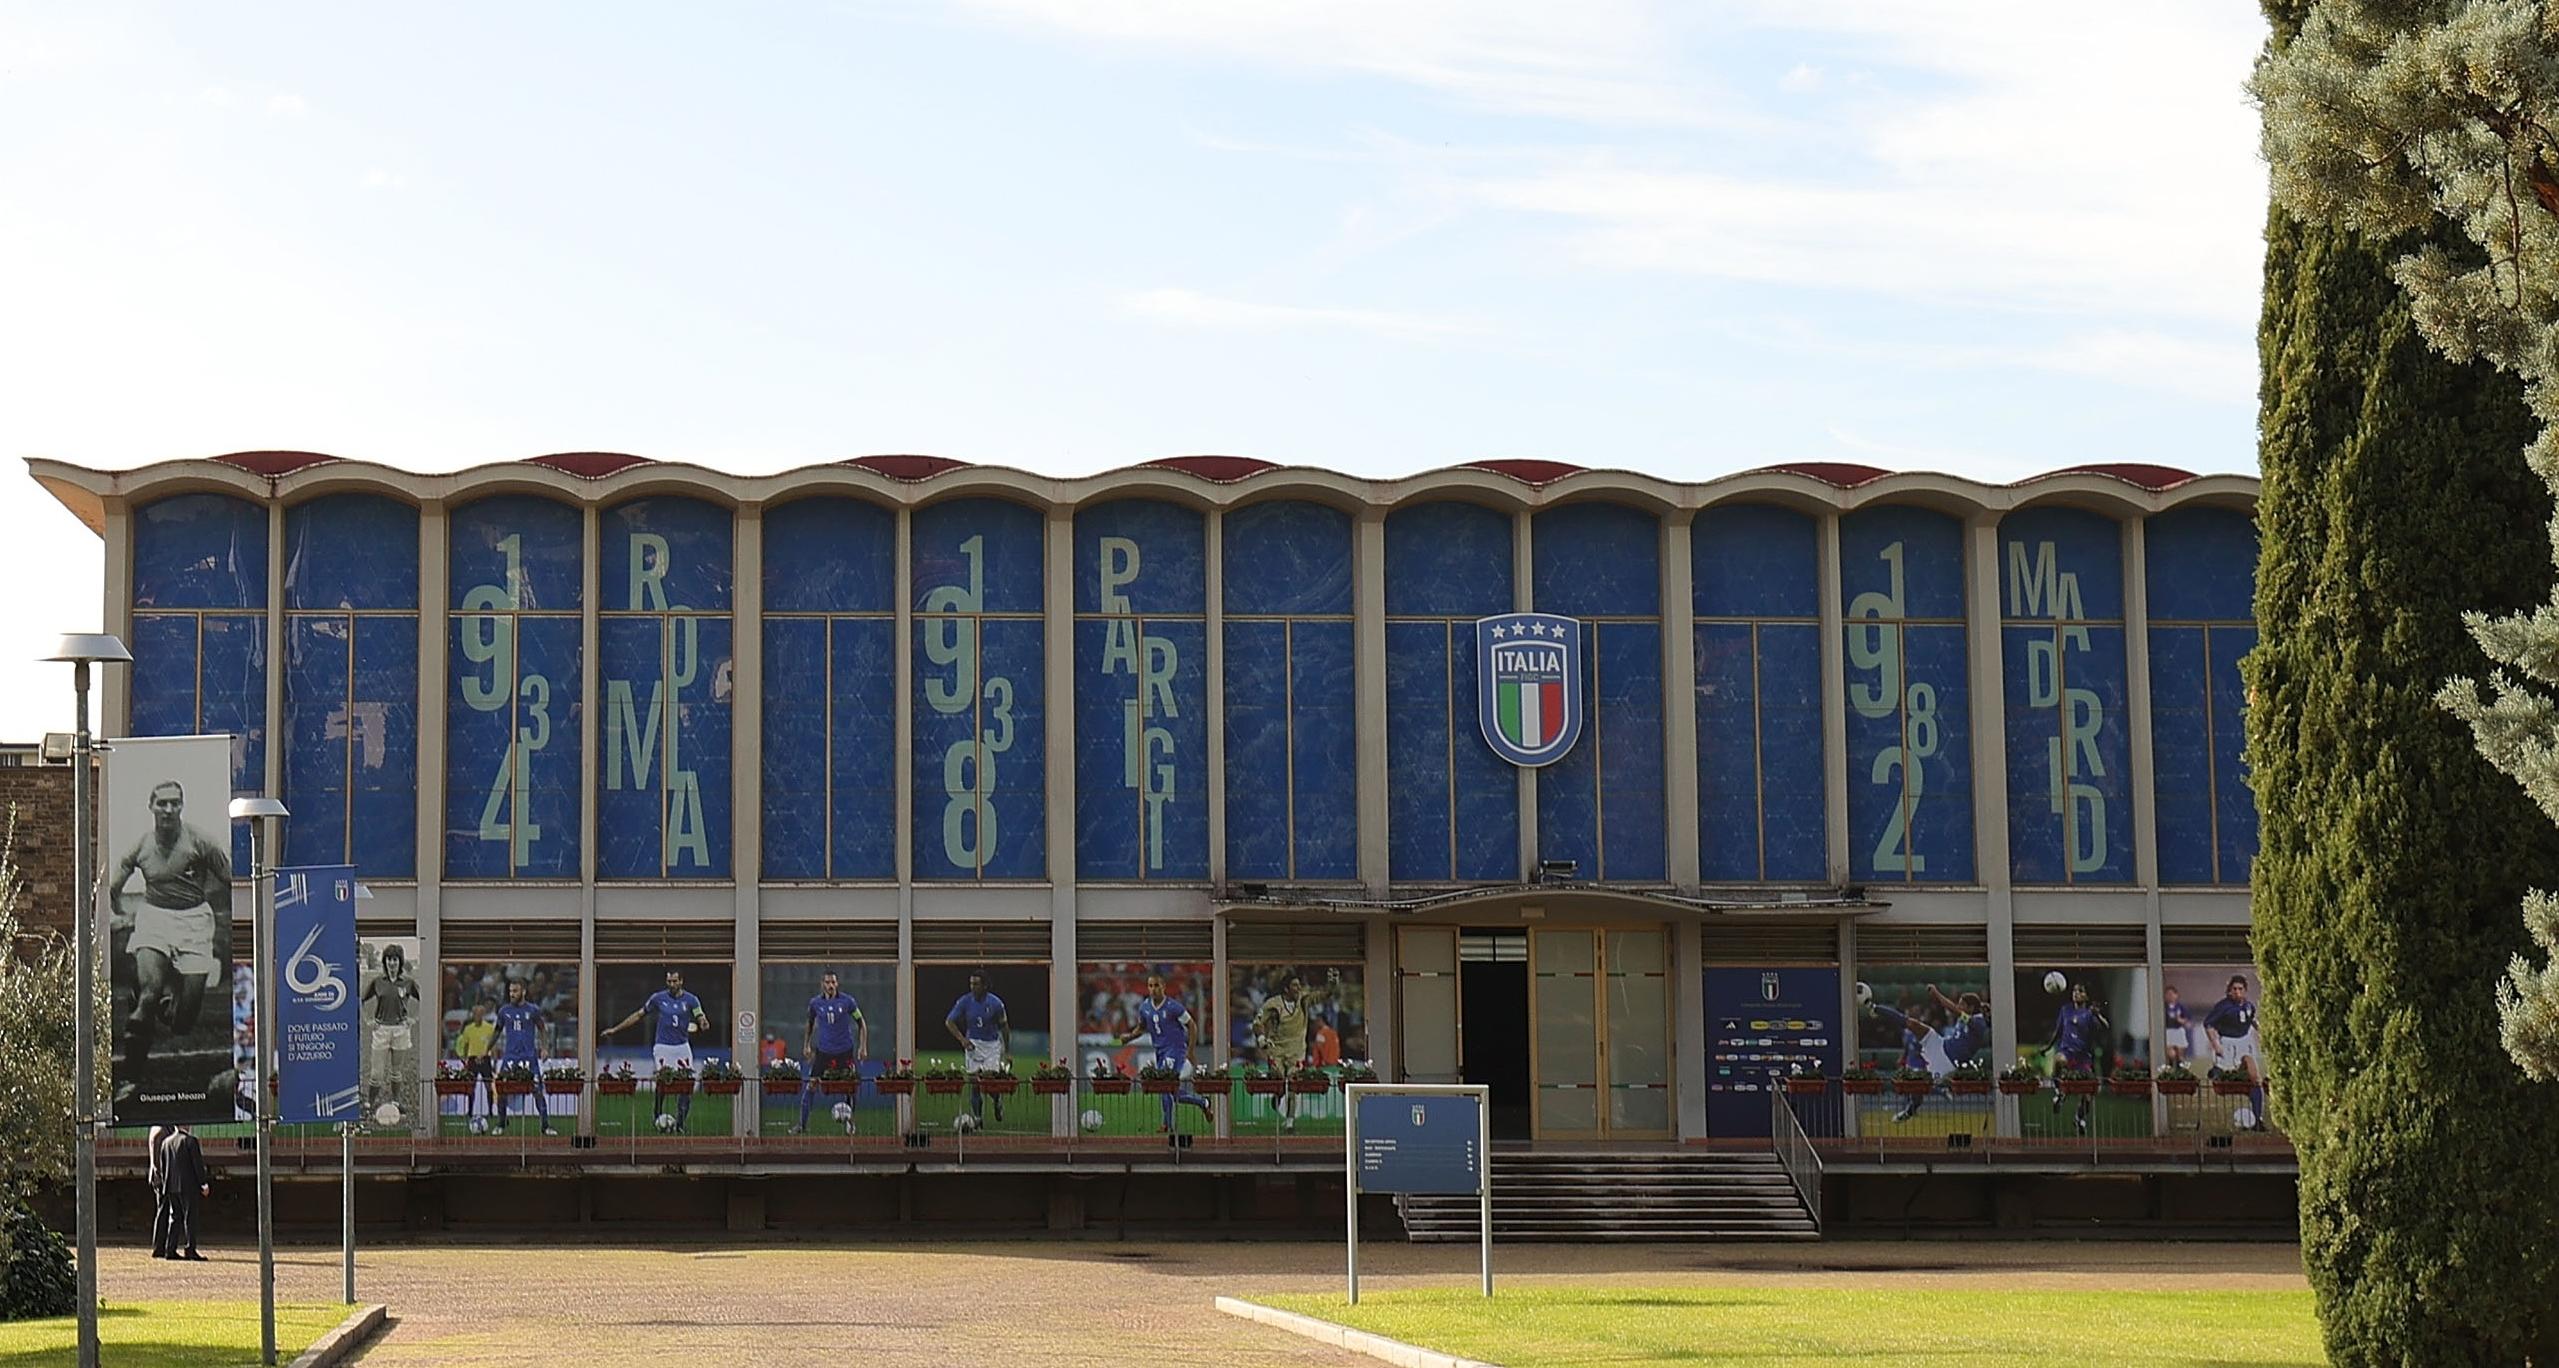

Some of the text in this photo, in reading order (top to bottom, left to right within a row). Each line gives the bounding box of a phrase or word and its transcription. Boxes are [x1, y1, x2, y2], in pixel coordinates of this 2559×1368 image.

[1498, 651, 1560, 671] ITALIA
[461, 533, 550, 867] 1934
[924, 535, 1014, 868] 1938
[1848, 541, 1938, 872] 1982
[285, 923, 346, 1010] 65
[288, 1023, 348, 1033] DOVE PASSATO
[294, 1033, 325, 1042] FUTURO
[288, 1042, 335, 1051] SI TINGONO
[140, 1092, 206, 1102] Giuseppe Meazza
